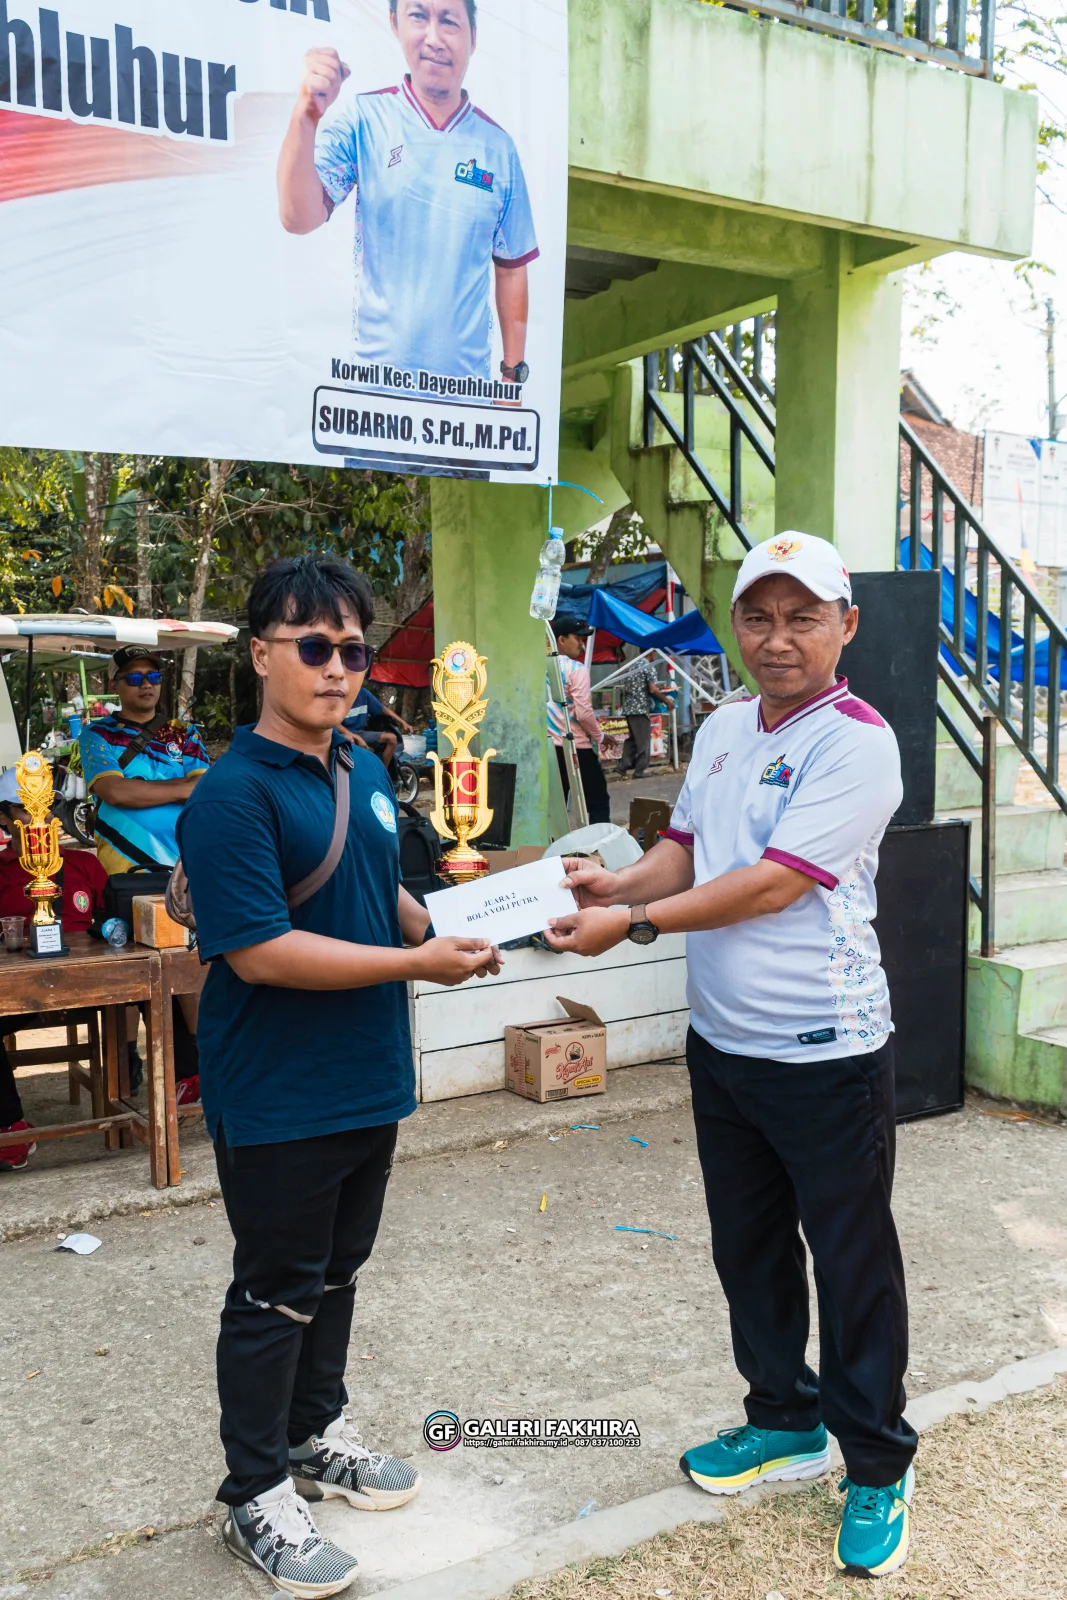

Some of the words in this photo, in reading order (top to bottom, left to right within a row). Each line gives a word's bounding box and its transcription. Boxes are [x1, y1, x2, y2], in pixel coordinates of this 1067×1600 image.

[331, 357, 380, 385] Korwil
[383, 366, 415, 390] Kec.
[418, 371, 523, 401] Dayeuhluhur
[318, 405, 417, 445] SUBARNO,
[421, 417, 533, 452] S.Pd.,M.Pd.
[467, 911, 489, 922] BOLA
[490, 904, 510, 914] VOLI
[512, 895, 539, 908] PUTRA
[483, 894, 510, 908] JUARA
